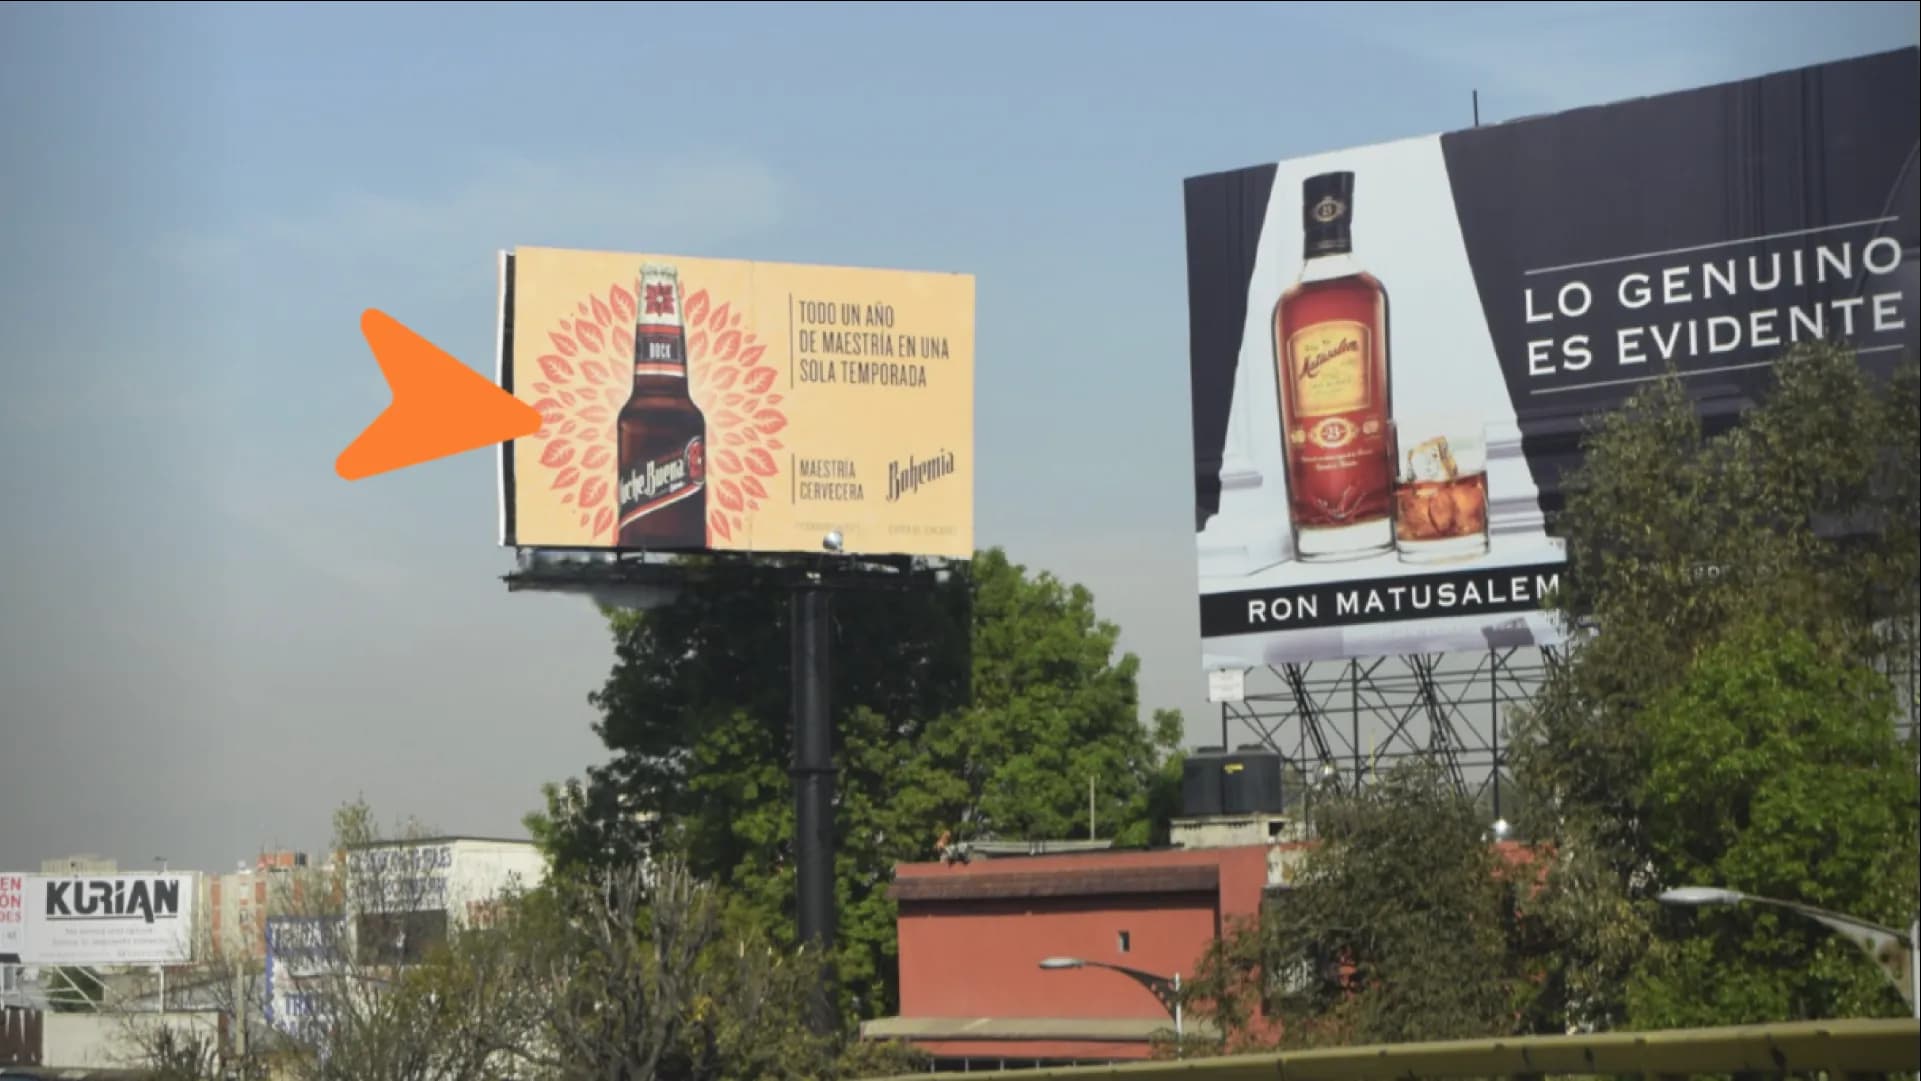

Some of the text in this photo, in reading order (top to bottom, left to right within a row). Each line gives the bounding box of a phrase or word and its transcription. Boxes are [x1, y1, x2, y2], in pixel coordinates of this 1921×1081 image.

[1525, 237, 1902, 323] LO GENUINO
[799, 300, 895, 328] TODO UN AÑO
[1527, 292, 1905, 376] ES EVIDENTE
[799, 330, 949, 359] DE MAESTRÍA EN UNA
[800, 359, 927, 387] SOLA TEMPORADA
[799, 482, 864, 501] CERVECERA
[886, 448, 955, 502] Bohemia
[1248, 573, 1561, 624] RON MATUSALEM
